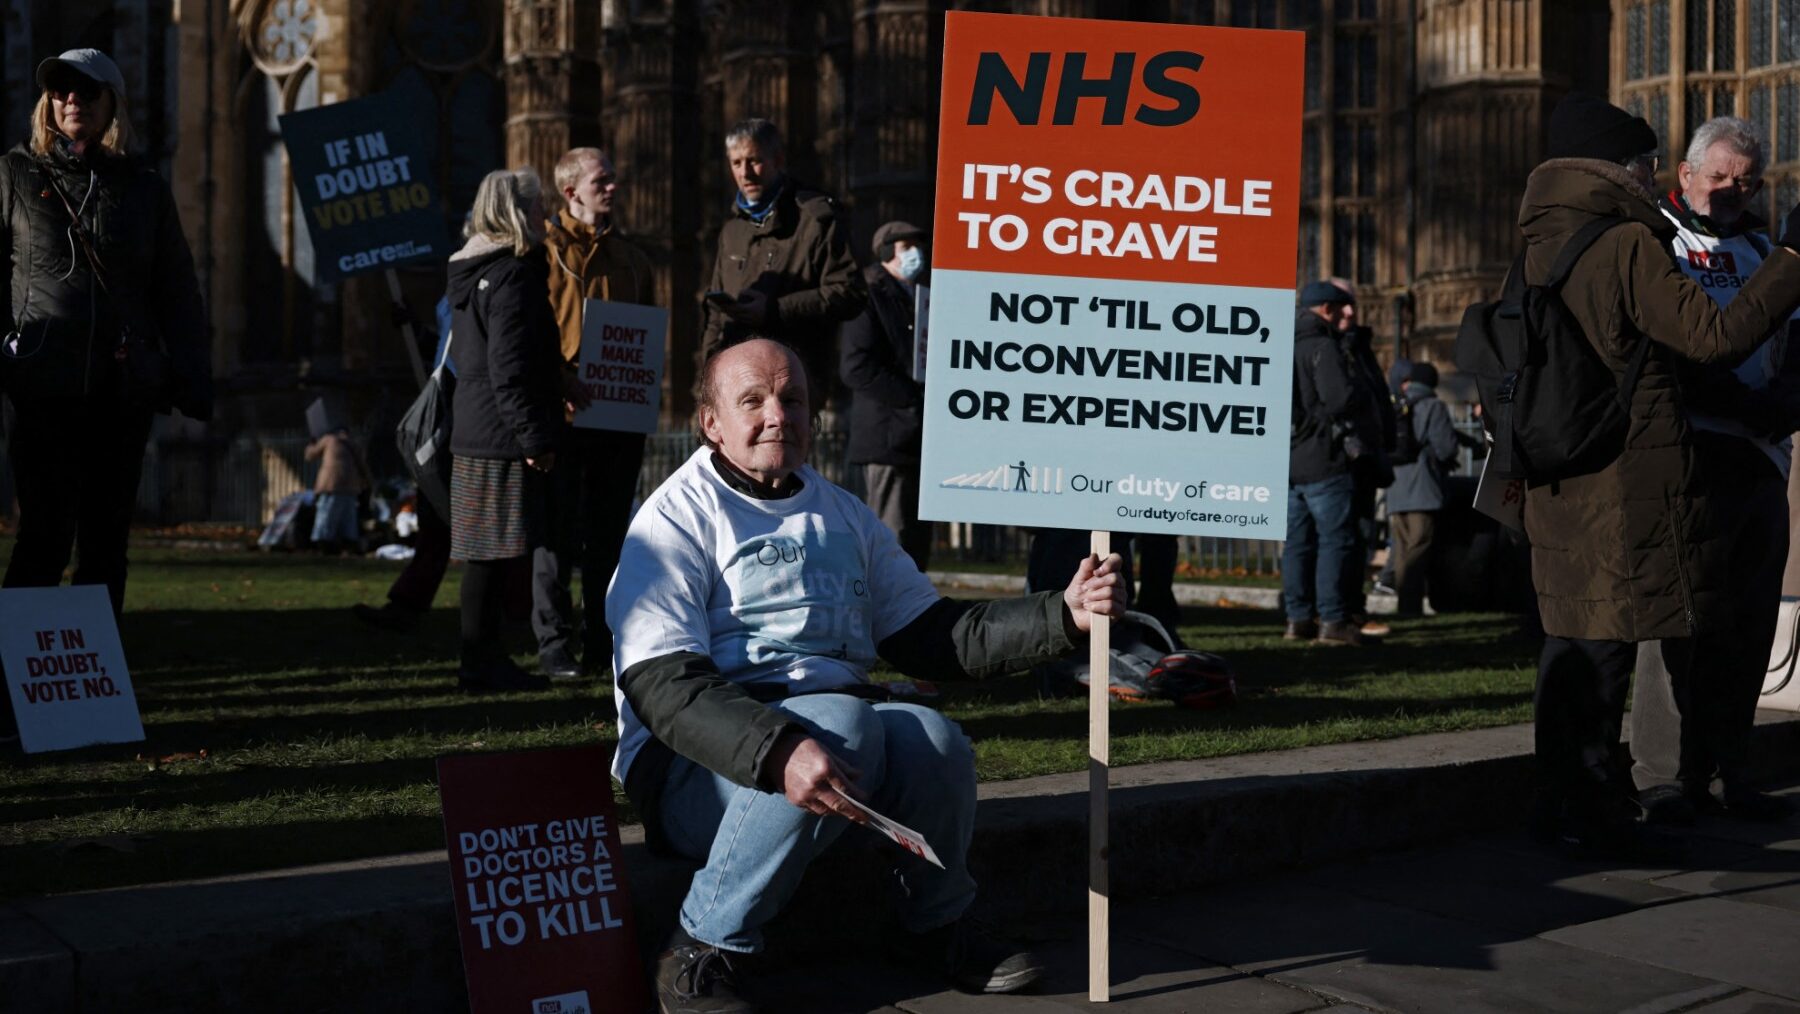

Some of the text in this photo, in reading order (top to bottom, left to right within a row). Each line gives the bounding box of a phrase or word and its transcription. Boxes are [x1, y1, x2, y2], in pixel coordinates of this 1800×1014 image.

[967, 51, 1205, 126] NHS
[323, 131, 389, 168] IF IN
[314, 155, 412, 200] DOUBT
[962, 163, 1272, 217] IT’S CRADLE
[312, 182, 431, 230] VOTE NO
[958, 211, 1218, 263] TO GRAVE
[338, 245, 397, 272] care
[602, 324, 648, 345] DON'T
[990, 292, 1270, 343] NOT ‘TIL OLD,
[586, 362, 657, 386] DOCTORS
[601, 345, 645, 365] MAKE
[950, 339, 1270, 386] INCONVENIENT
[948, 389, 1267, 437] OR EXPENSIVE!
[1071, 473, 1271, 503] Our duty of care
[1116, 505, 1270, 527] Ourdutyofcare.org.uk
[757, 544, 806, 566] Our
[35, 629, 85, 651] IF IN
[26, 653, 106, 677] DOUBT,
[21, 676, 121, 704] VOTE NO.
[459, 815, 608, 855] DON’T GIVE
[464, 839, 611, 879] DOCTORS A
[466, 862, 617, 912] LICENCE
[470, 896, 623, 950] TO KILL
